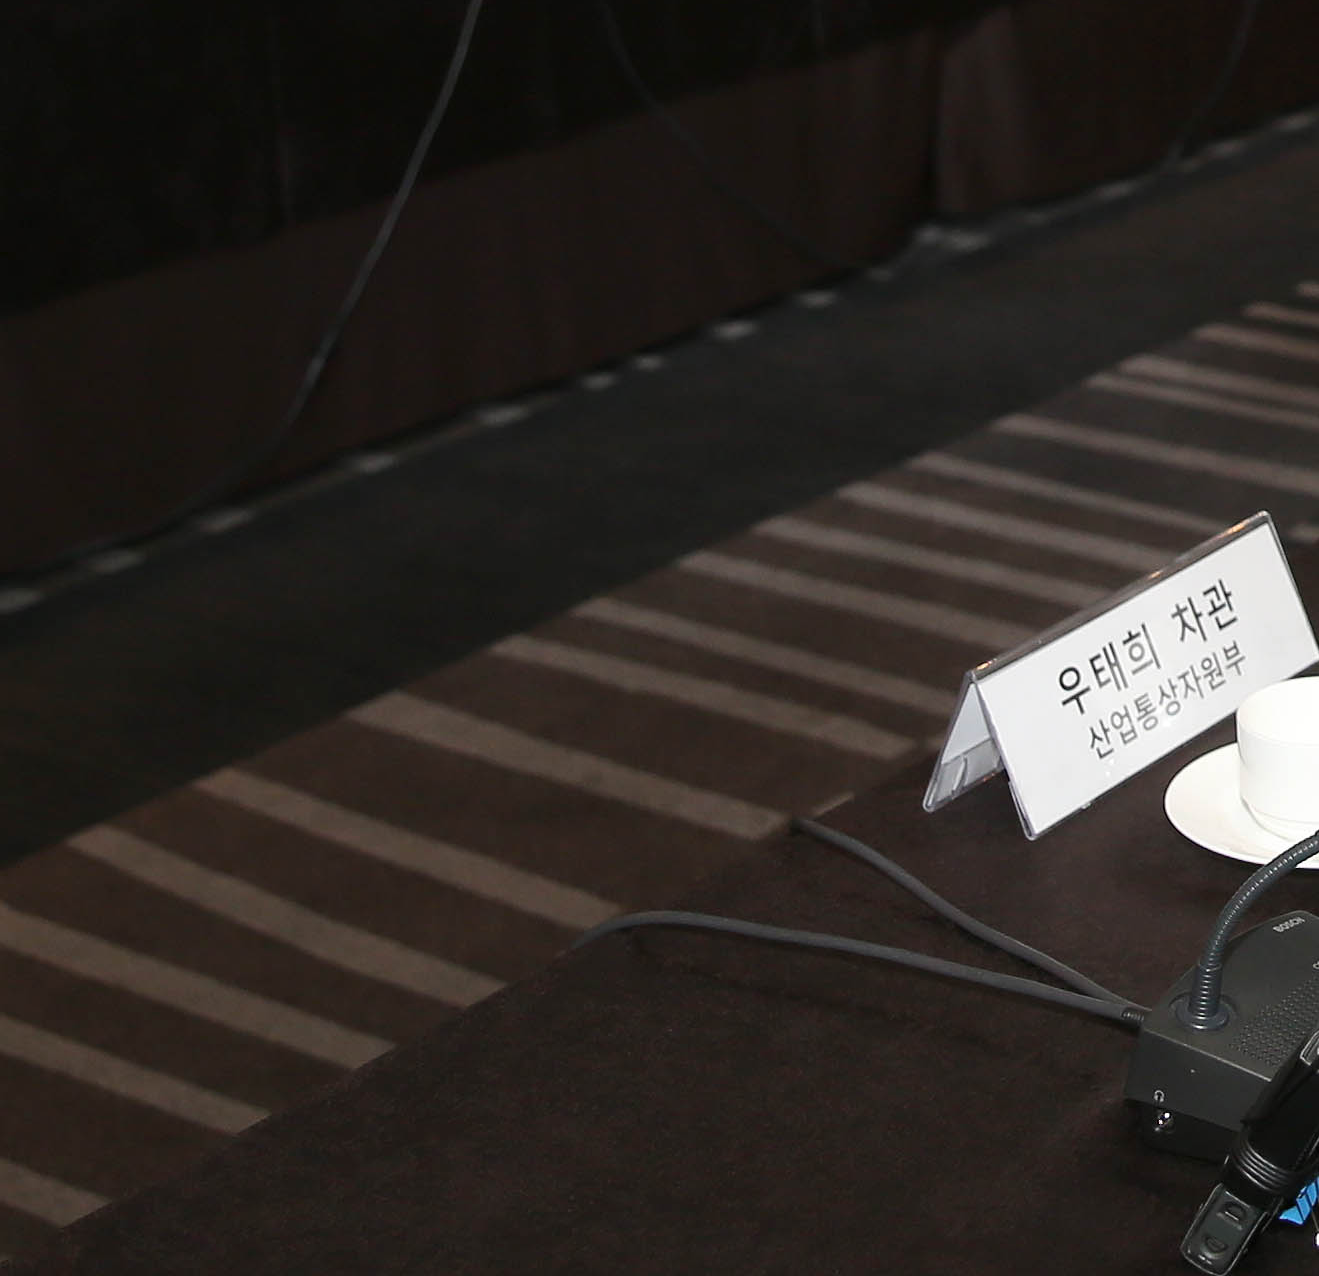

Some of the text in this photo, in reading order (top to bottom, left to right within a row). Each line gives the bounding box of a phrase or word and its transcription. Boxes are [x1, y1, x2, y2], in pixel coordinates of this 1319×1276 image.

[1058, 579, 1239, 714] 우태희 차관
[1089, 641, 1246, 759] 산업통상자원부
[1272, 917, 1305, 932] BOSCH
